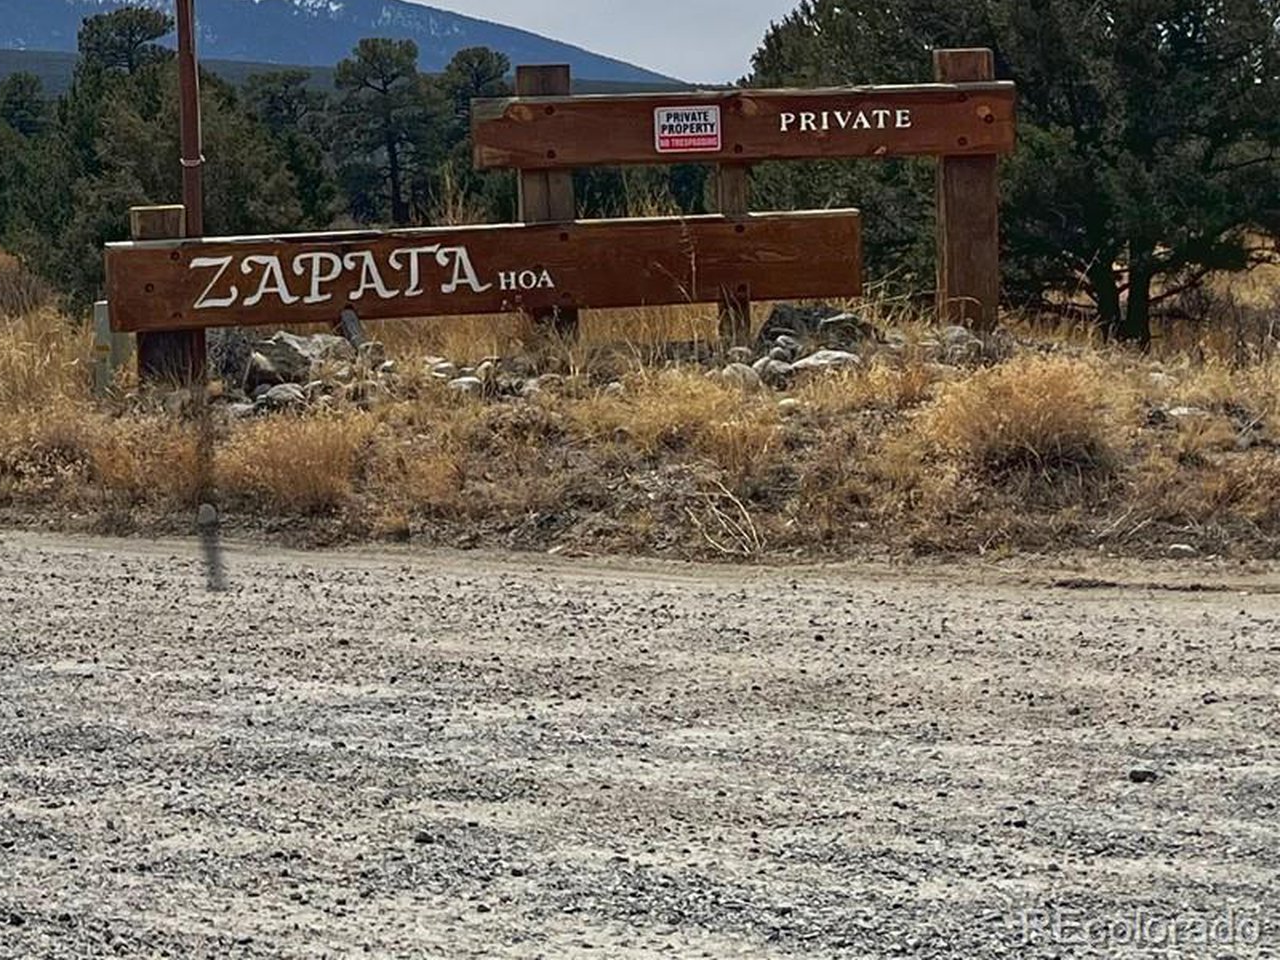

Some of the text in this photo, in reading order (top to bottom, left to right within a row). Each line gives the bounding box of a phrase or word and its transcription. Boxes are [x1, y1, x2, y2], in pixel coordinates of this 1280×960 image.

[666, 112, 709, 122] PRIVATE
[780, 109, 912, 132] PRIVATE
[661, 123, 715, 134] PROPERTY
[189, 243, 554, 309] ZAPATA HOA
